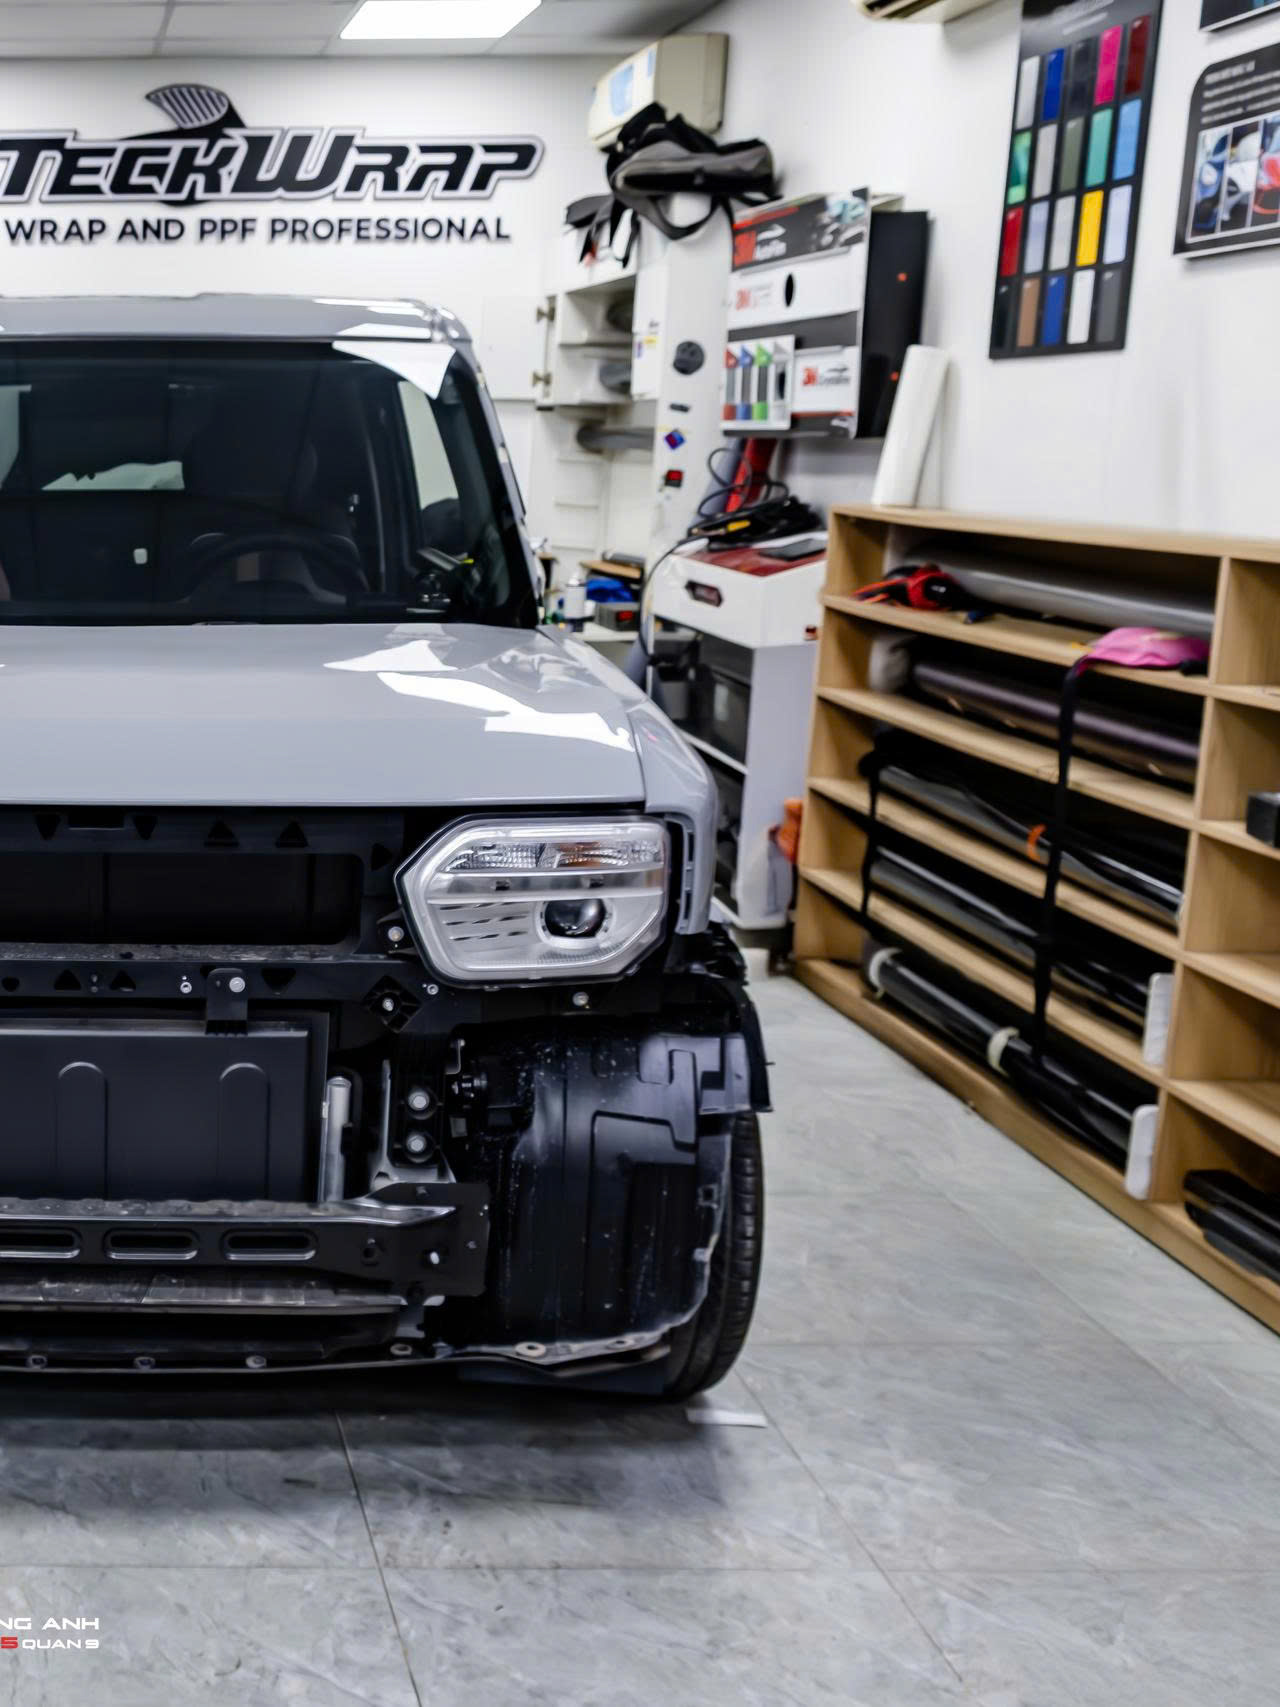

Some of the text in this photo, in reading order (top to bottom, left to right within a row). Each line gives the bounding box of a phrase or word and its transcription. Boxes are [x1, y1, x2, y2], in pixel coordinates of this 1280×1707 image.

[5, 216, 511, 243] WRAP AND PPF PROFESSIONAL
